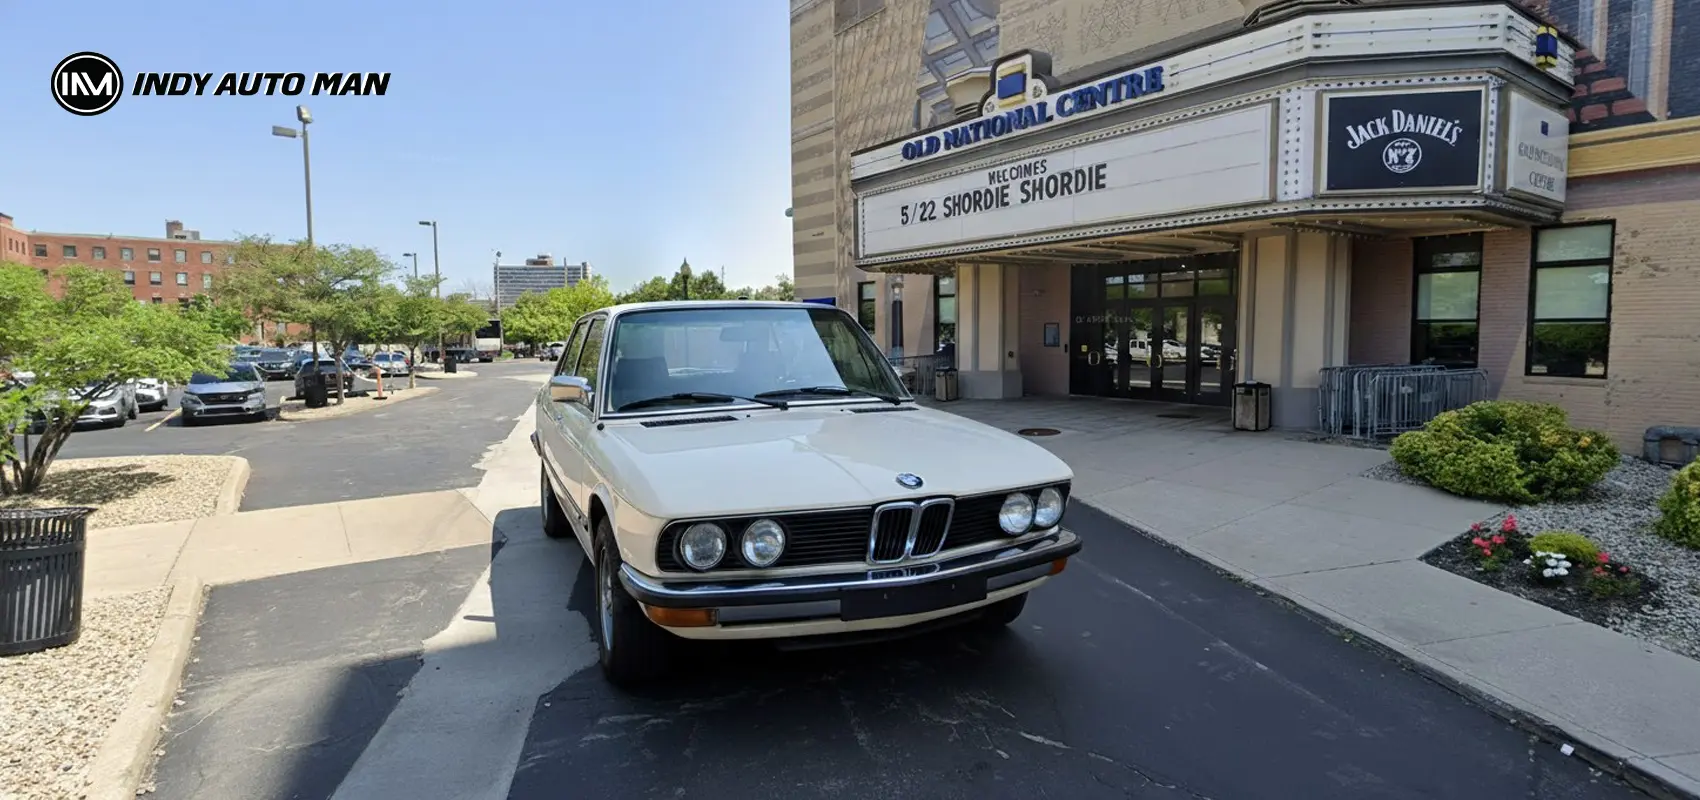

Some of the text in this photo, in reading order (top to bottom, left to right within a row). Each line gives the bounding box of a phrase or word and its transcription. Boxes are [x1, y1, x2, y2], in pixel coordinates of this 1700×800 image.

[901, 65, 1165, 161] OLD NATIONAL CENTRE
[1346, 116, 1389, 149] JACK
[900, 162, 1107, 226] 5/22 SHORDIE SHORDIE
